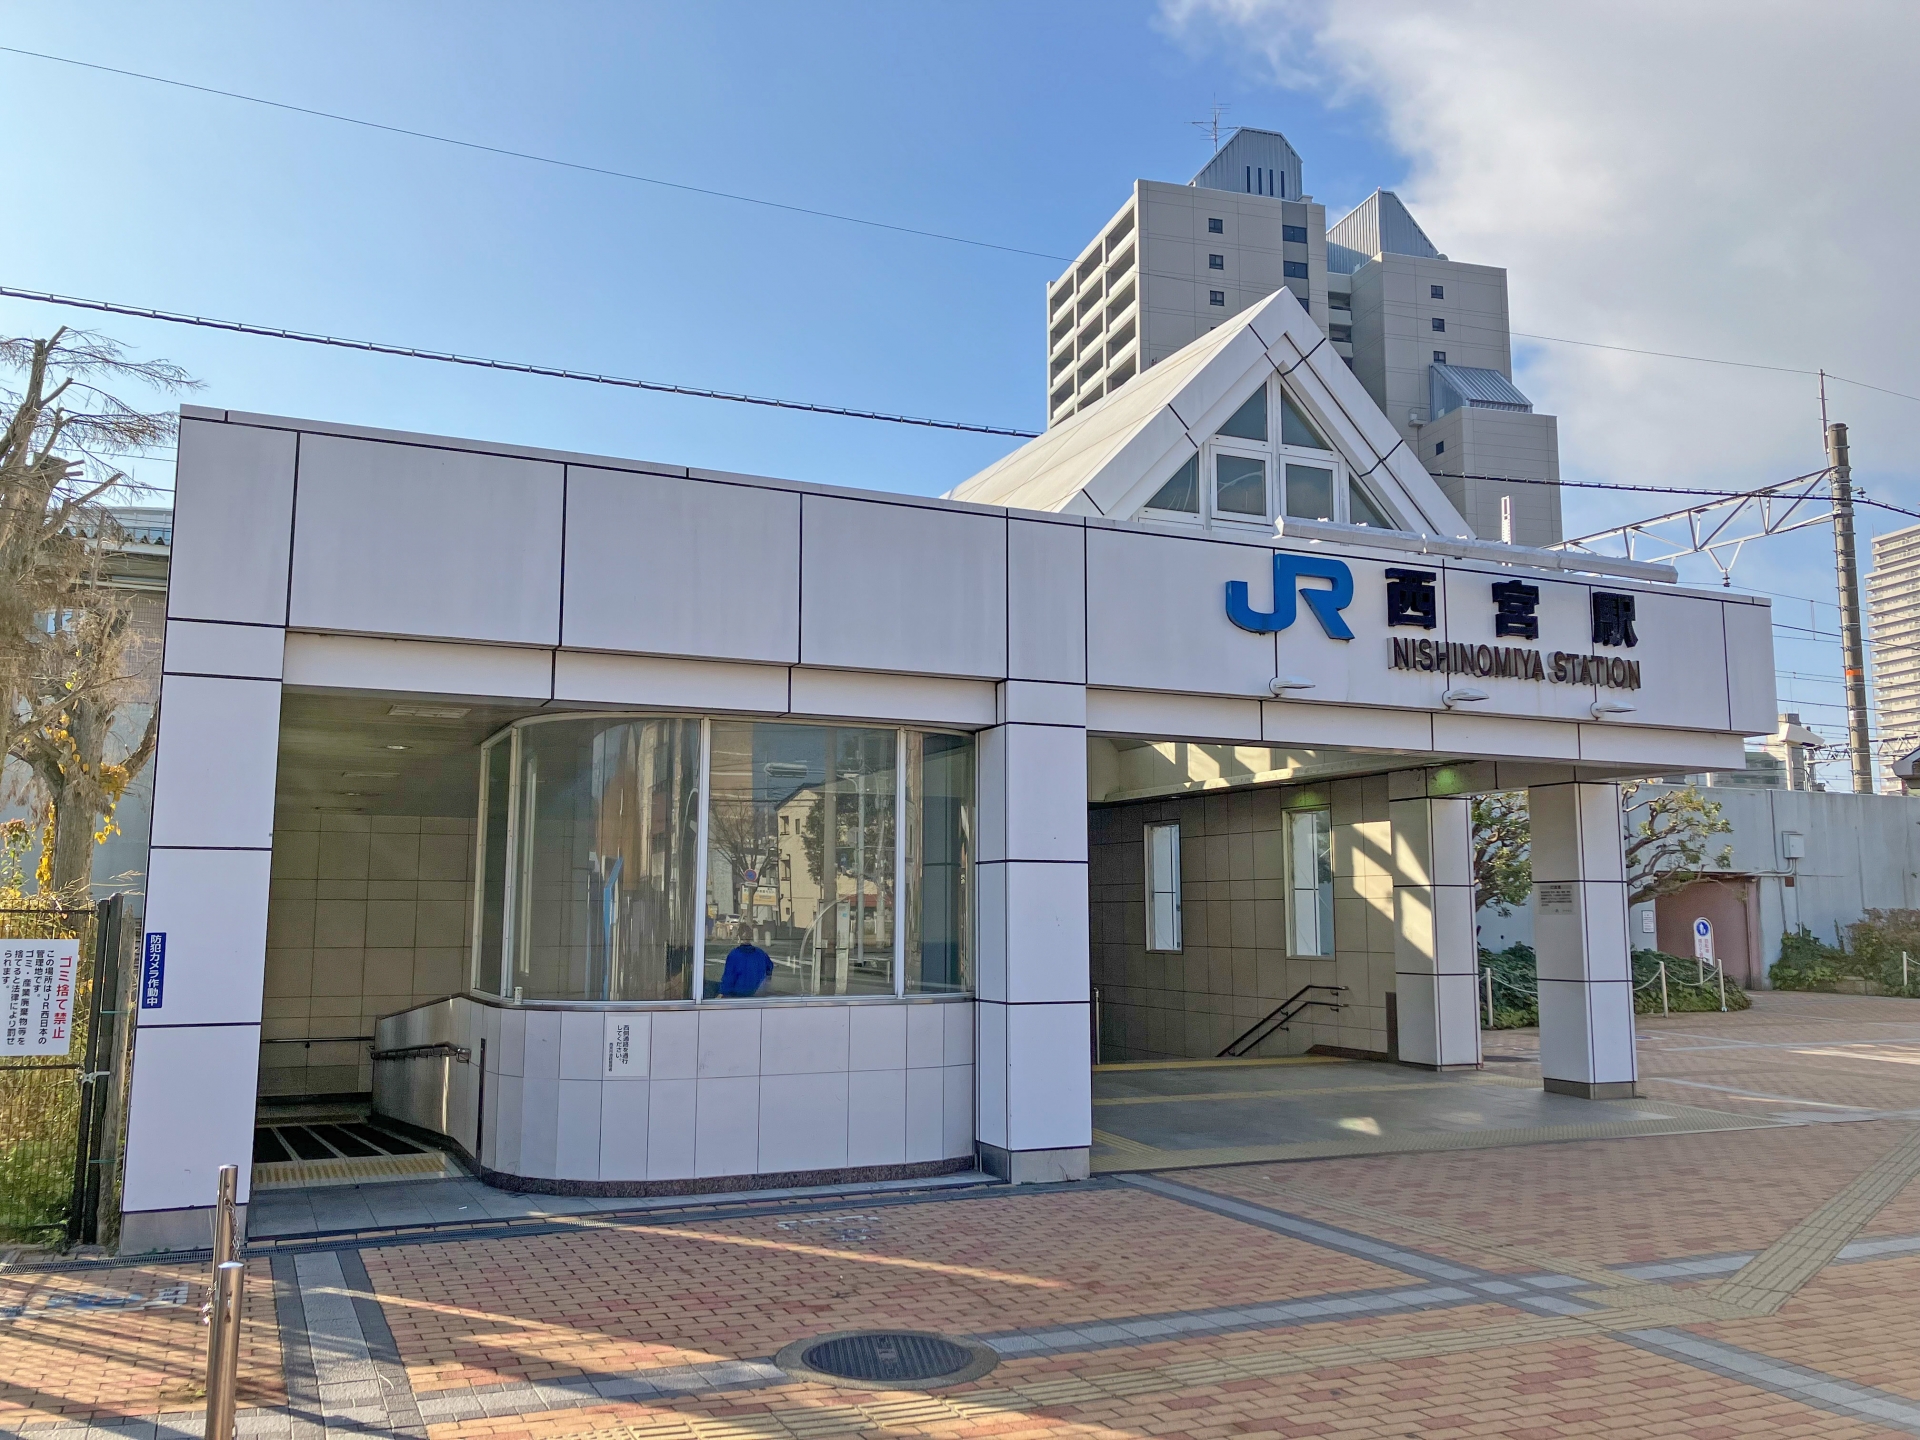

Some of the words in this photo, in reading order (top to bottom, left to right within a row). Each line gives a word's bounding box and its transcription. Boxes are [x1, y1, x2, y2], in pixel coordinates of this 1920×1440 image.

[1225, 553, 1355, 640] JR
[1386, 567, 1638, 648] 西宮駅
[1387, 636, 1545, 681] NISHINOMIYA
[1548, 651, 1642, 690] STATION
[2, 949, 12, 989] られます。
[33, 949, 45, 997] 管理地です。
[52, 955, 72, 1039] ゴミ捨て禁止
[147, 934, 162, 1007] 防犯カメラ作動中
